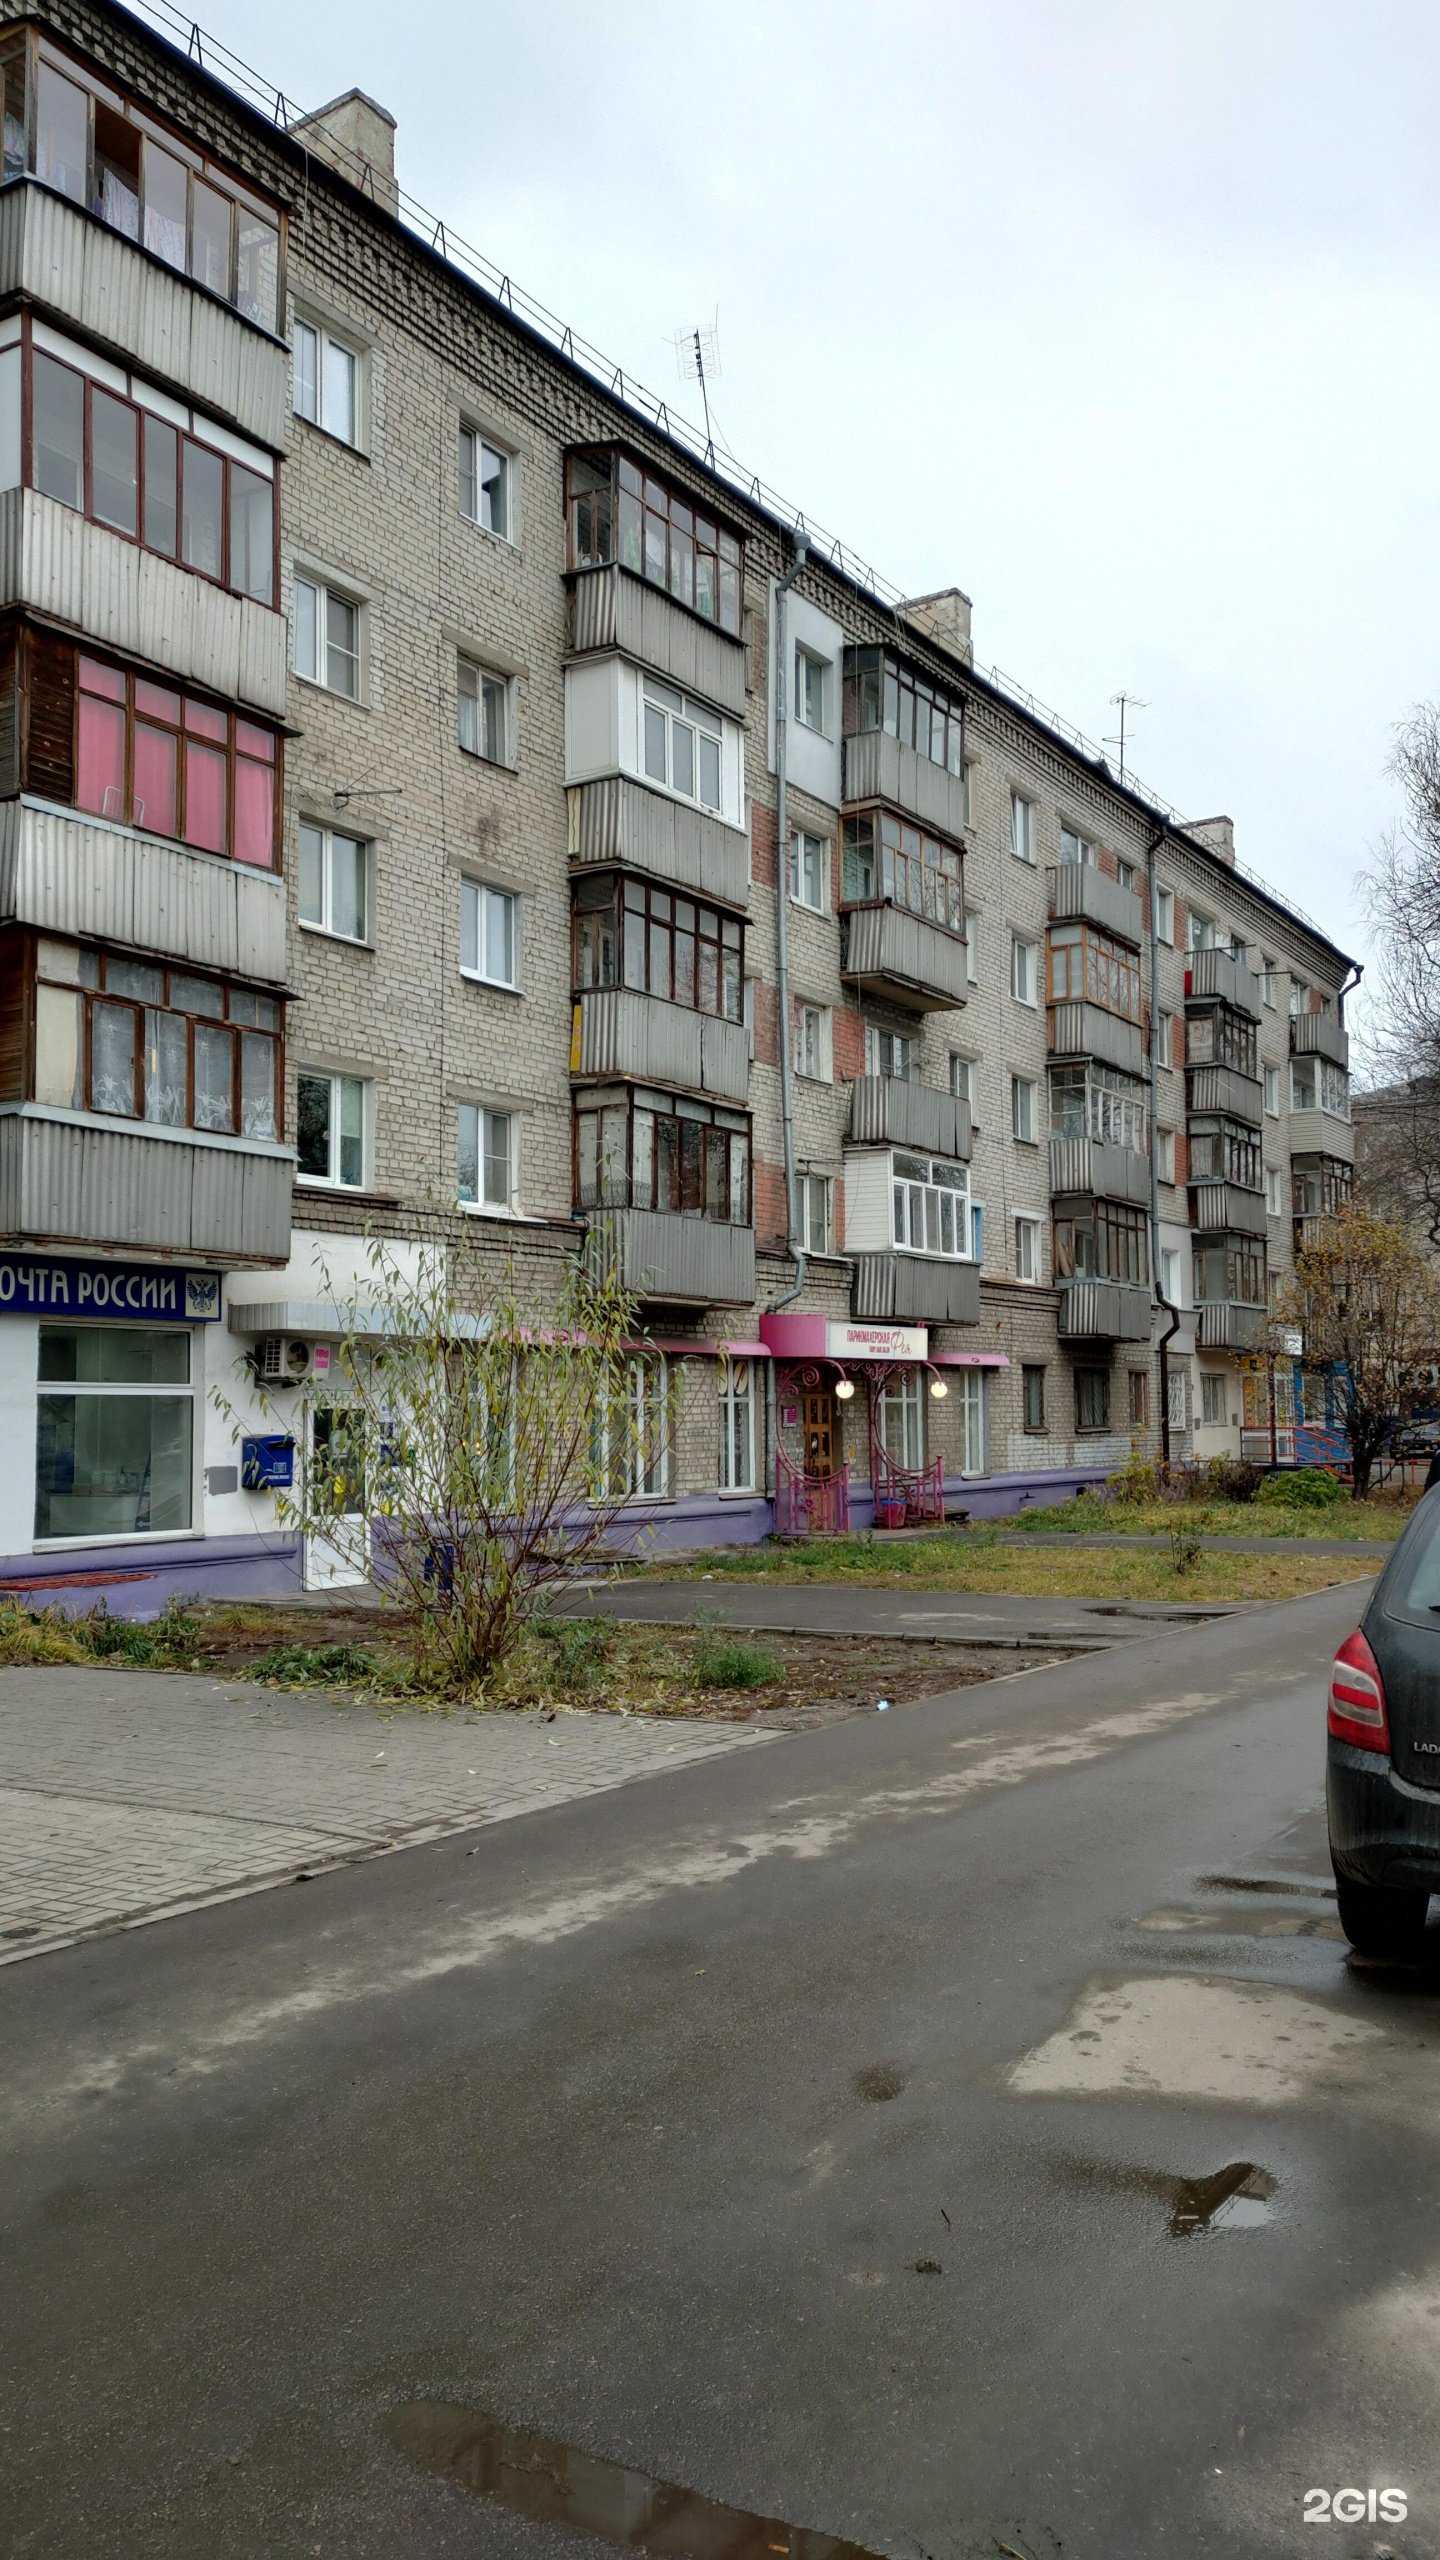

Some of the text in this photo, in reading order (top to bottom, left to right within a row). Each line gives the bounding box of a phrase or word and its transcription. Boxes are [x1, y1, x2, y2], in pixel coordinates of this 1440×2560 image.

[0, 1265, 176, 1309] ОЧТА РОССИИ
[1414, 1741, 1440, 1754] LAD
